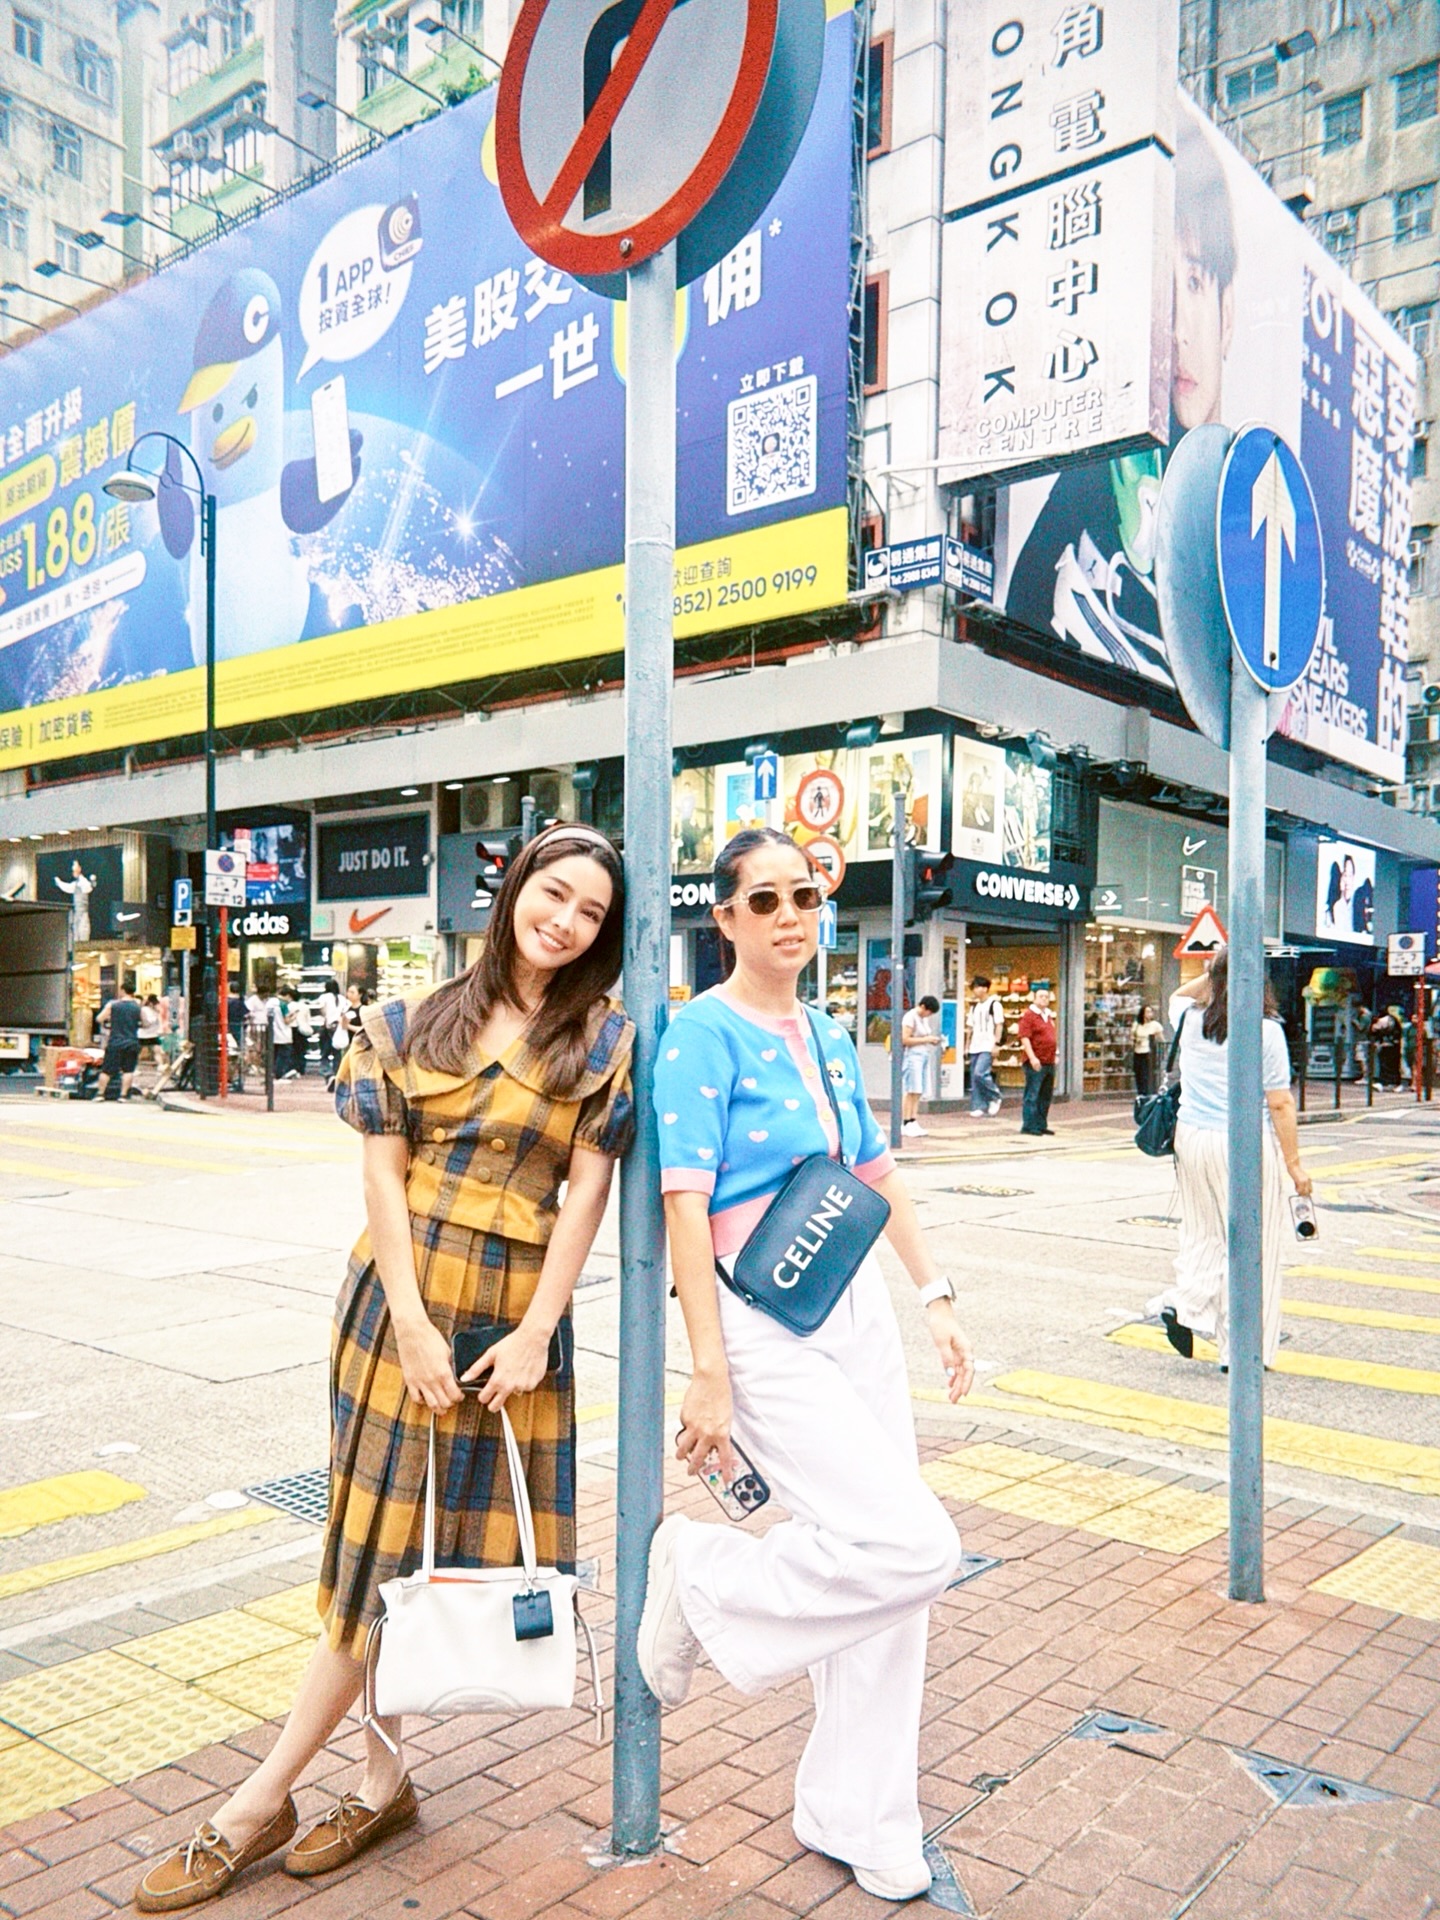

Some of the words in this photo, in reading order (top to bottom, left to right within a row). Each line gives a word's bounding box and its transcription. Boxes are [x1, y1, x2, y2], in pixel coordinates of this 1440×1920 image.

[318, 262, 329, 303] 1
[335, 257, 374, 296] APP
[983, 212, 1019, 403] KOK
[0, 386, 82, 468] 全面升級
[977, 388, 1103, 439] COMPUTER
[718, 576, 767, 606] 2500
[773, 565, 817, 594] 9199
[338, 850, 368, 872] JUST
[371, 848, 391, 869] DO
[394, 846, 410, 867] IT.
[178, 883, 189, 909] P
[232, 895, 243, 904] 12
[976, 871, 1065, 907] CONVERSE
[772, 1184, 854, 1289] CELINE
